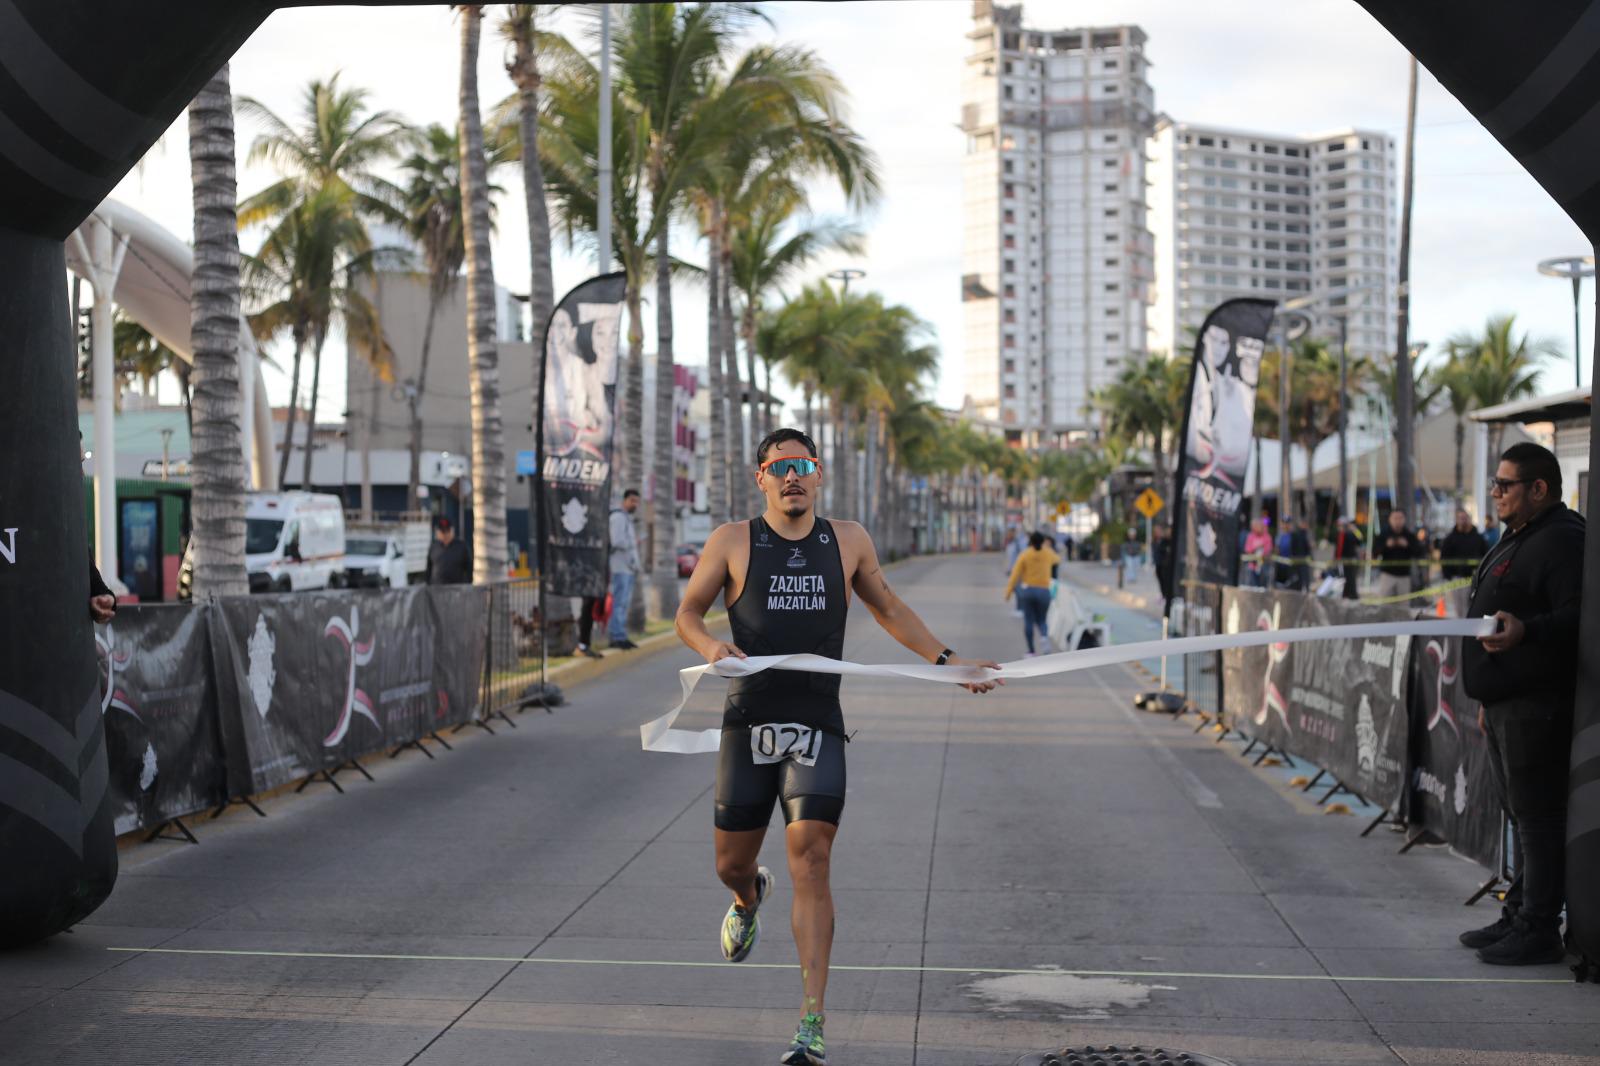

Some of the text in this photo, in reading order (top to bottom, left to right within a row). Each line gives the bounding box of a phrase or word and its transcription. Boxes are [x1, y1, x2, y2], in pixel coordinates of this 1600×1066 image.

[543, 456, 609, 481] IMDEM
[769, 575, 825, 593] ZAZUETA
[767, 593, 826, 610] MAZATLÁN
[758, 726, 817, 759] 021
